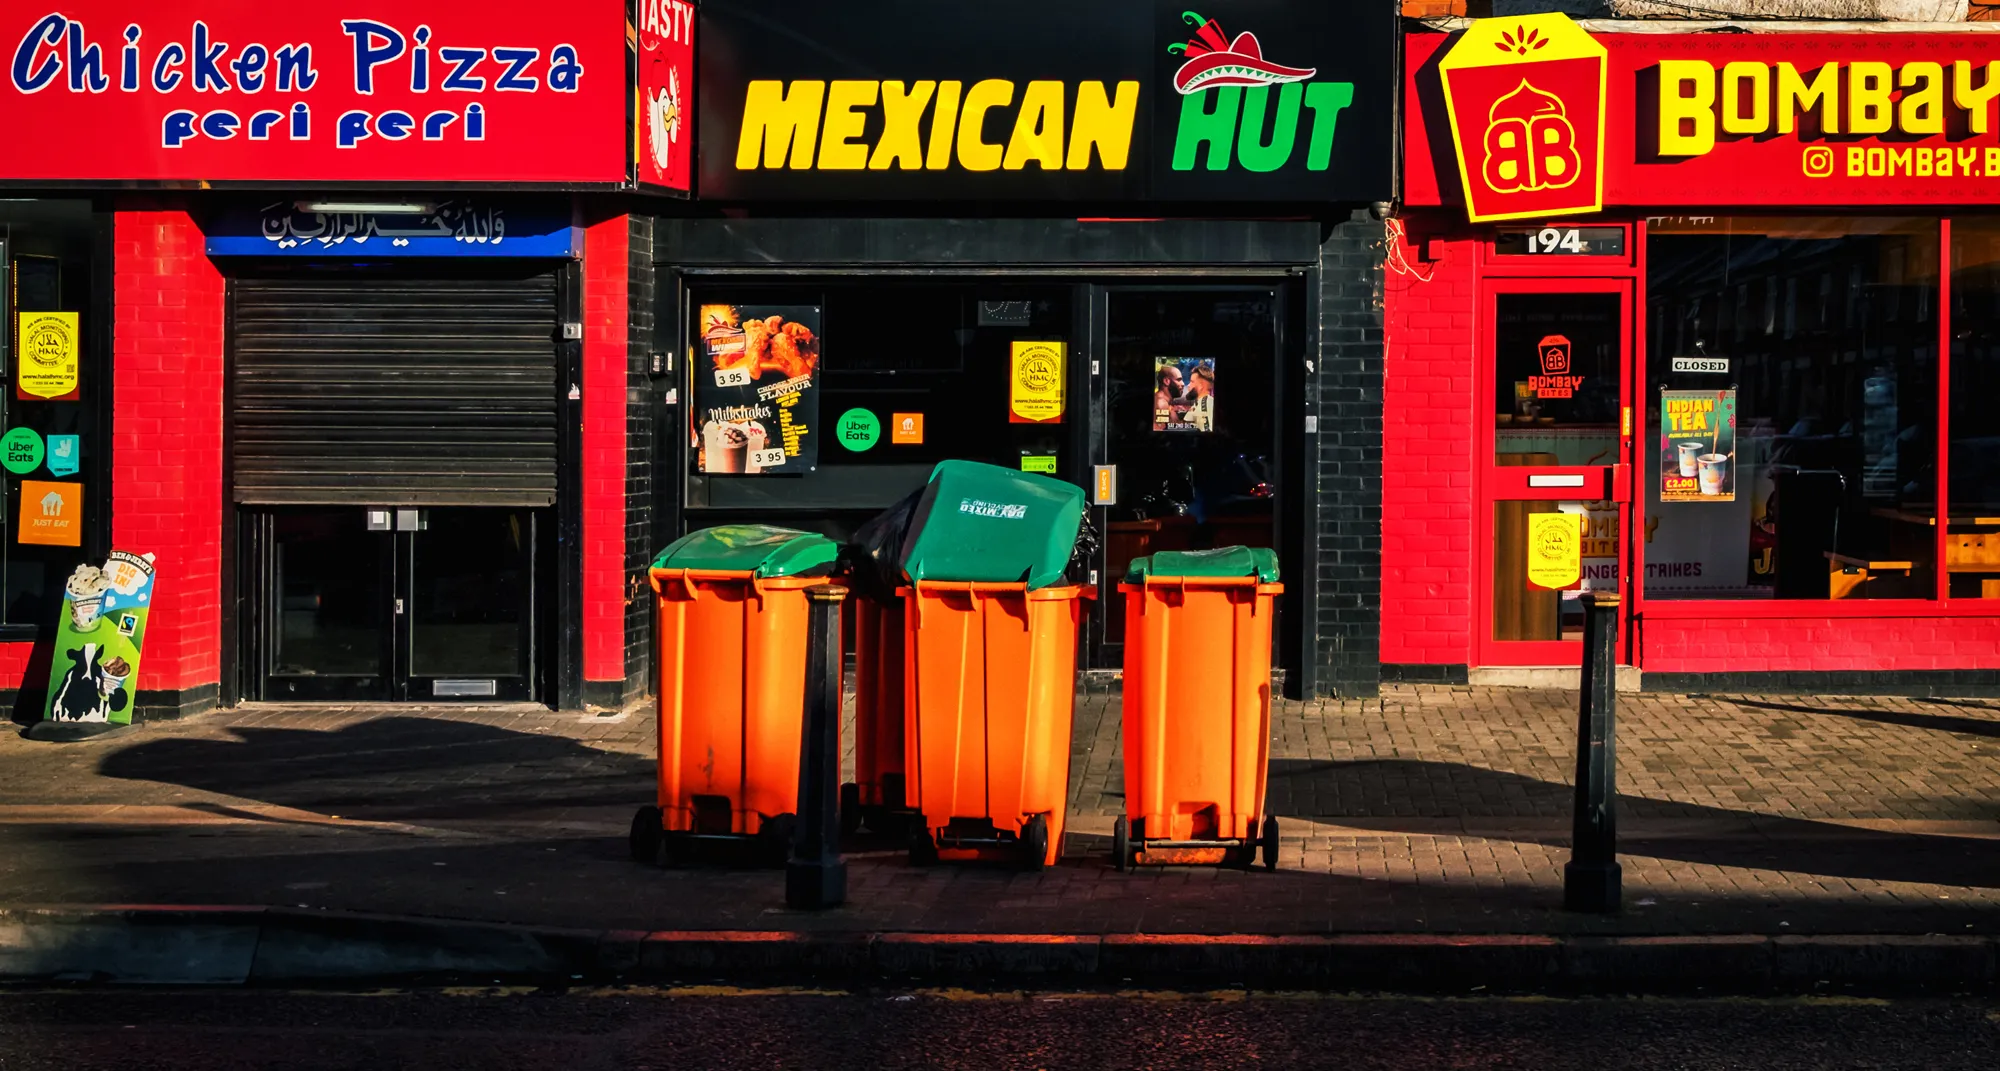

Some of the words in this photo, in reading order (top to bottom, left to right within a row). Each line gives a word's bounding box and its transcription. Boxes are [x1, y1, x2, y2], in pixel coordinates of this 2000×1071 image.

[640, 0, 693, 45] TASTY
[11, 12, 318, 93] Chicken
[341, 18, 584, 94] Pizza
[736, 78, 1140, 171] MEXICAN
[1171, 82, 1354, 171] HUT
[1528, 228, 1582, 253] 194
[40, 325, 69, 344] MONITORING
[1675, 361, 1726, 371] CLOSED
[719, 376, 726, 385] 3
[729, 373, 743, 383] 95
[759, 380, 812, 401] FLAVOUR
[708, 403, 772, 422] Milkshakes
[1666, 400, 1714, 413] INDIAN
[846, 421, 871, 430] Uber
[1668, 412, 1708, 431] TEA
[846, 431, 870, 440] Eats
[8, 441, 34, 452] Uber
[8, 452, 34, 462] Eats
[755, 454, 762, 462] 3
[768, 452, 781, 462] 95
[1666, 480, 1693, 488] £2.00
[960, 504, 997, 517] MIXED
[32, 519, 52, 527] JUST
[117, 562, 138, 578] DIG
[113, 574, 131, 588] IN!
